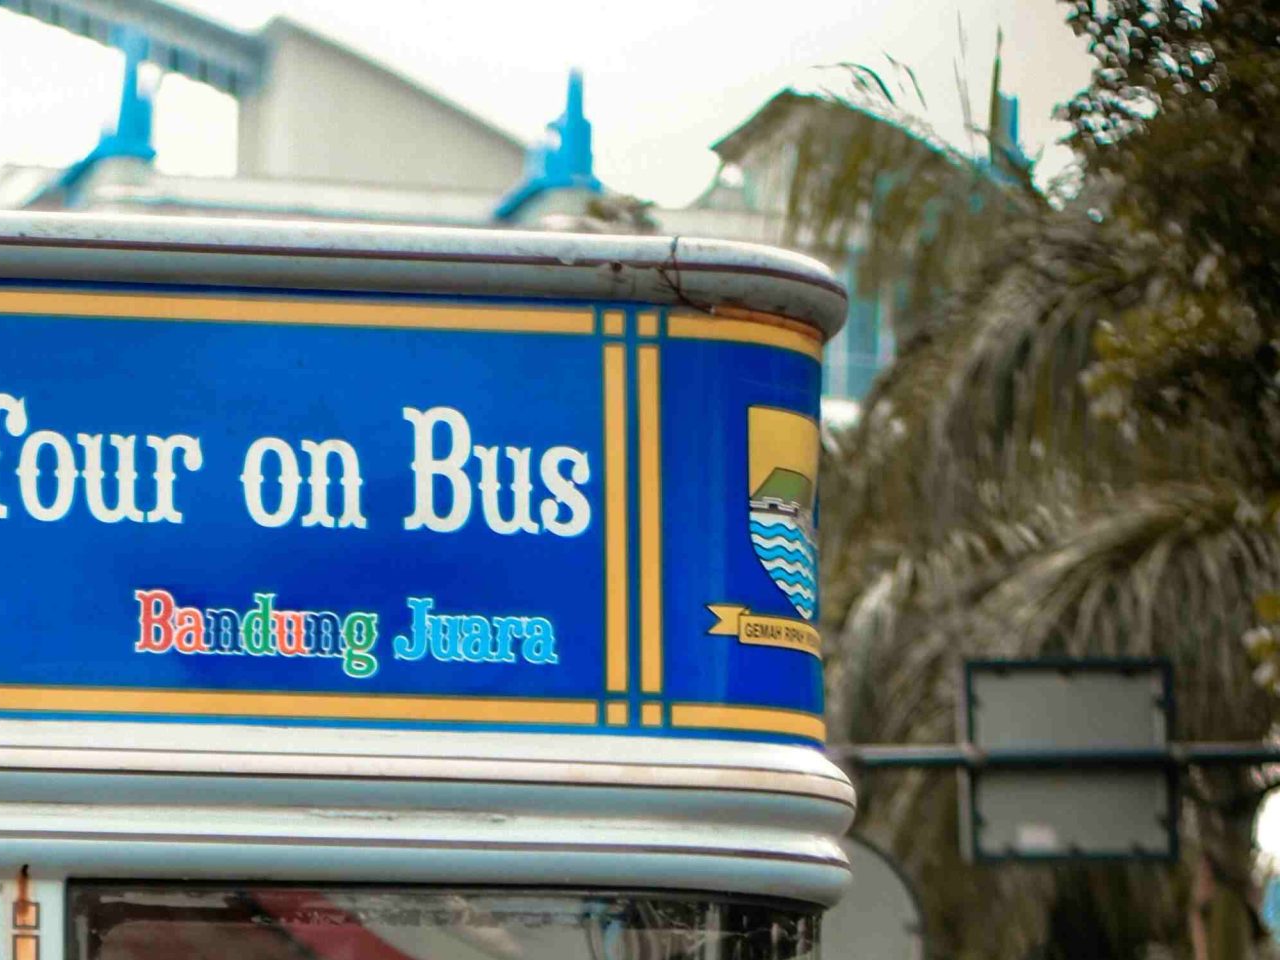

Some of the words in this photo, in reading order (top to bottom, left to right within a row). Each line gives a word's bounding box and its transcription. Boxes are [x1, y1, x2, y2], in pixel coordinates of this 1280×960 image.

[240, 437, 368, 529] on
[402, 406, 591, 536] Bus
[135, 590, 378, 678] Bandung
[394, 597, 557, 664] Juara
